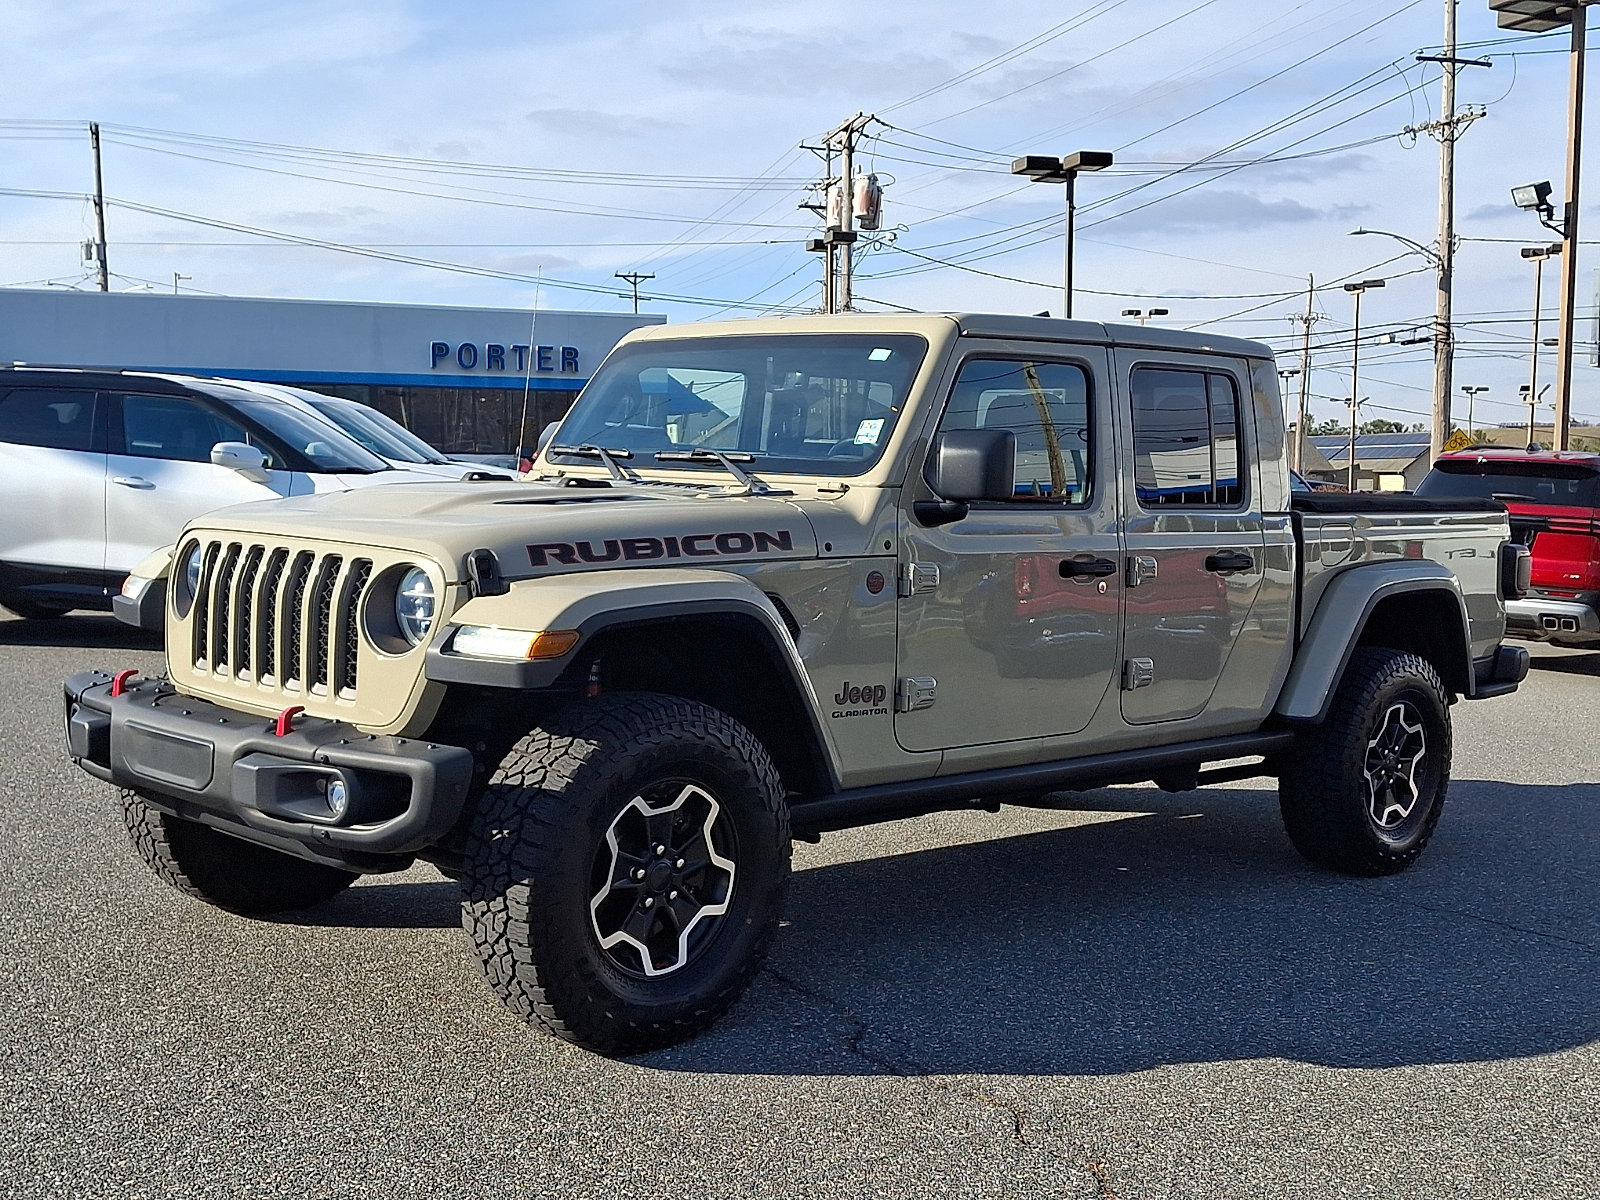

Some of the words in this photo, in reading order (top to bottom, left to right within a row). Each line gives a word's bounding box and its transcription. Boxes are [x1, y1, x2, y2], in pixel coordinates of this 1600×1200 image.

[430, 341, 580, 373] PORTER
[526, 530, 794, 567] RUBICON
[834, 681, 887, 706] Jeep
[831, 707, 888, 719] GLADIATOR
